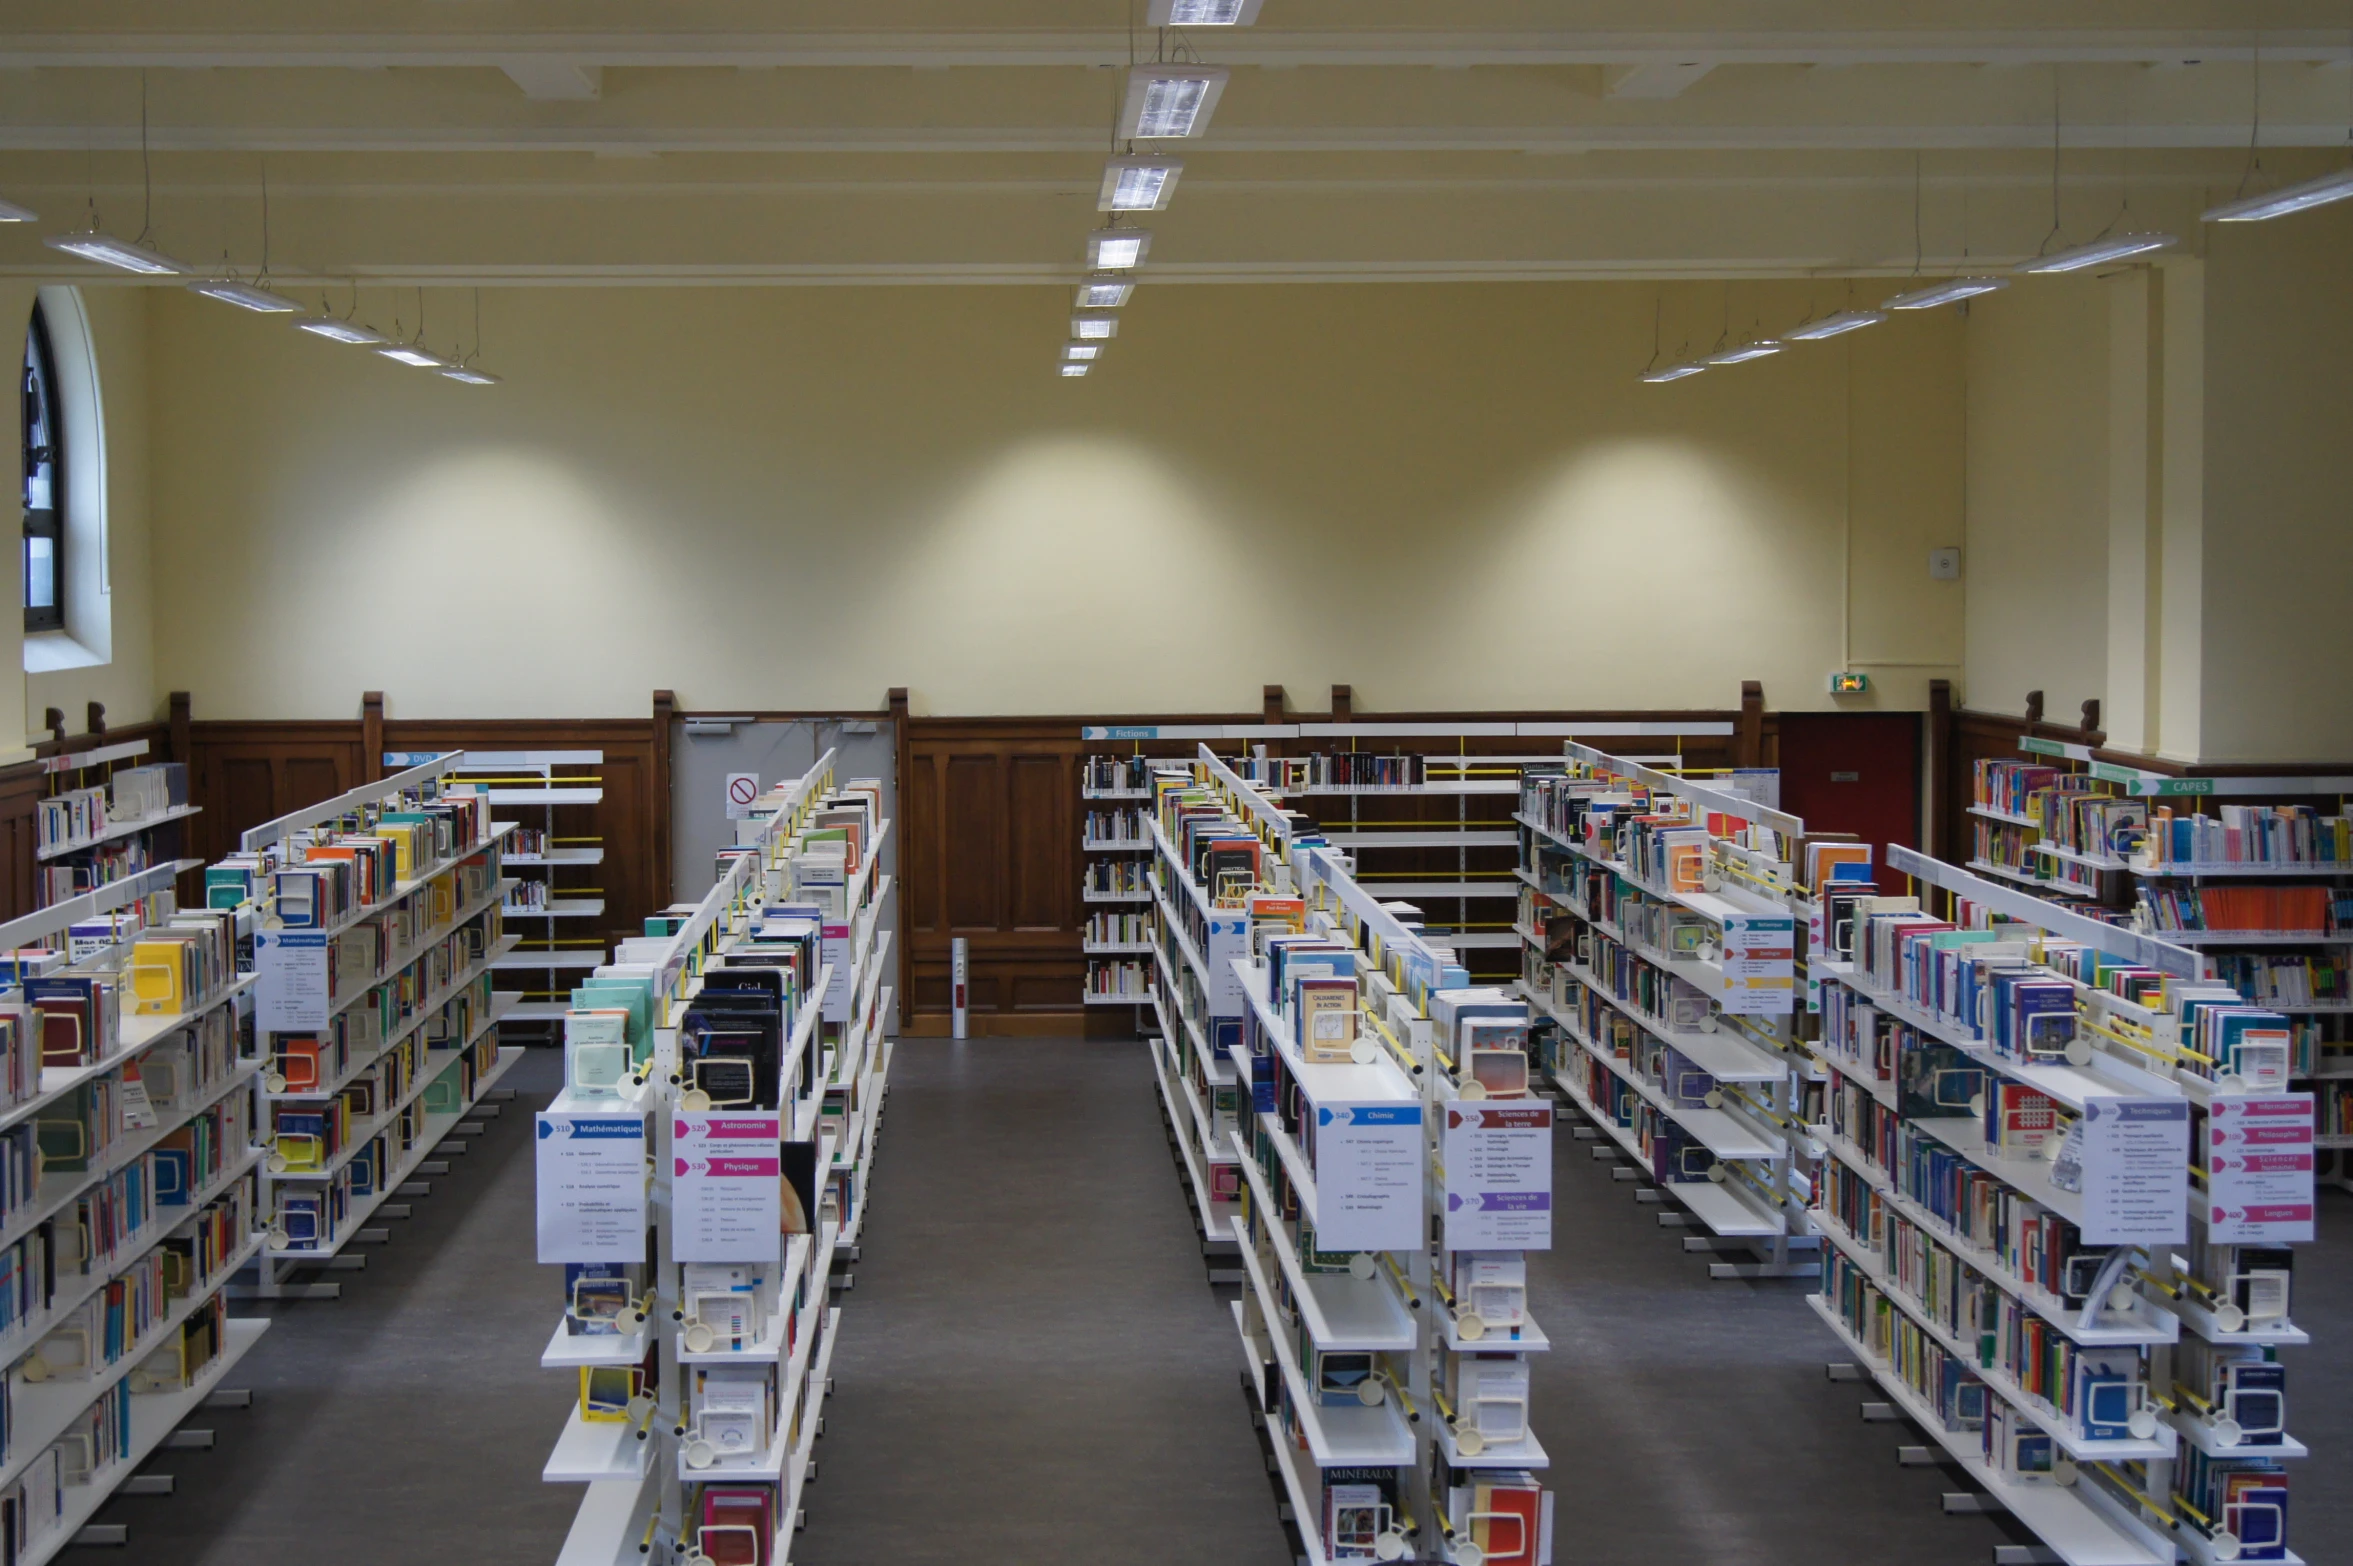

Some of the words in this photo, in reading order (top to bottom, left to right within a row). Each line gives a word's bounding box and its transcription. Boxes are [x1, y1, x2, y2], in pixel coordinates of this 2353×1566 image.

[1116, 729, 1149, 737] Fictions
[413, 755, 432, 763] DVD
[2173, 781, 2208, 792] CAPES
[2257, 1102, 2300, 1110] Information
[1367, 1111, 1394, 1119] Chimie
[1497, 1110, 1529, 1118] Sciences
[1529, 1110, 1539, 1118] de
[2129, 1107, 2172, 1115] Techniques
[1505, 1120, 1513, 1128] la
[1514, 1120, 1532, 1128] terre
[580, 1125, 642, 1133] Mathématiques
[2258, 1131, 2300, 1139] Philosophie
[723, 1162, 759, 1172] Physique
[1465, 1197, 1480, 1205] 570
[1528, 1194, 1538, 1202] de
[2227, 1211, 2242, 1219] 400
[2264, 1210, 2293, 1218] Langues
